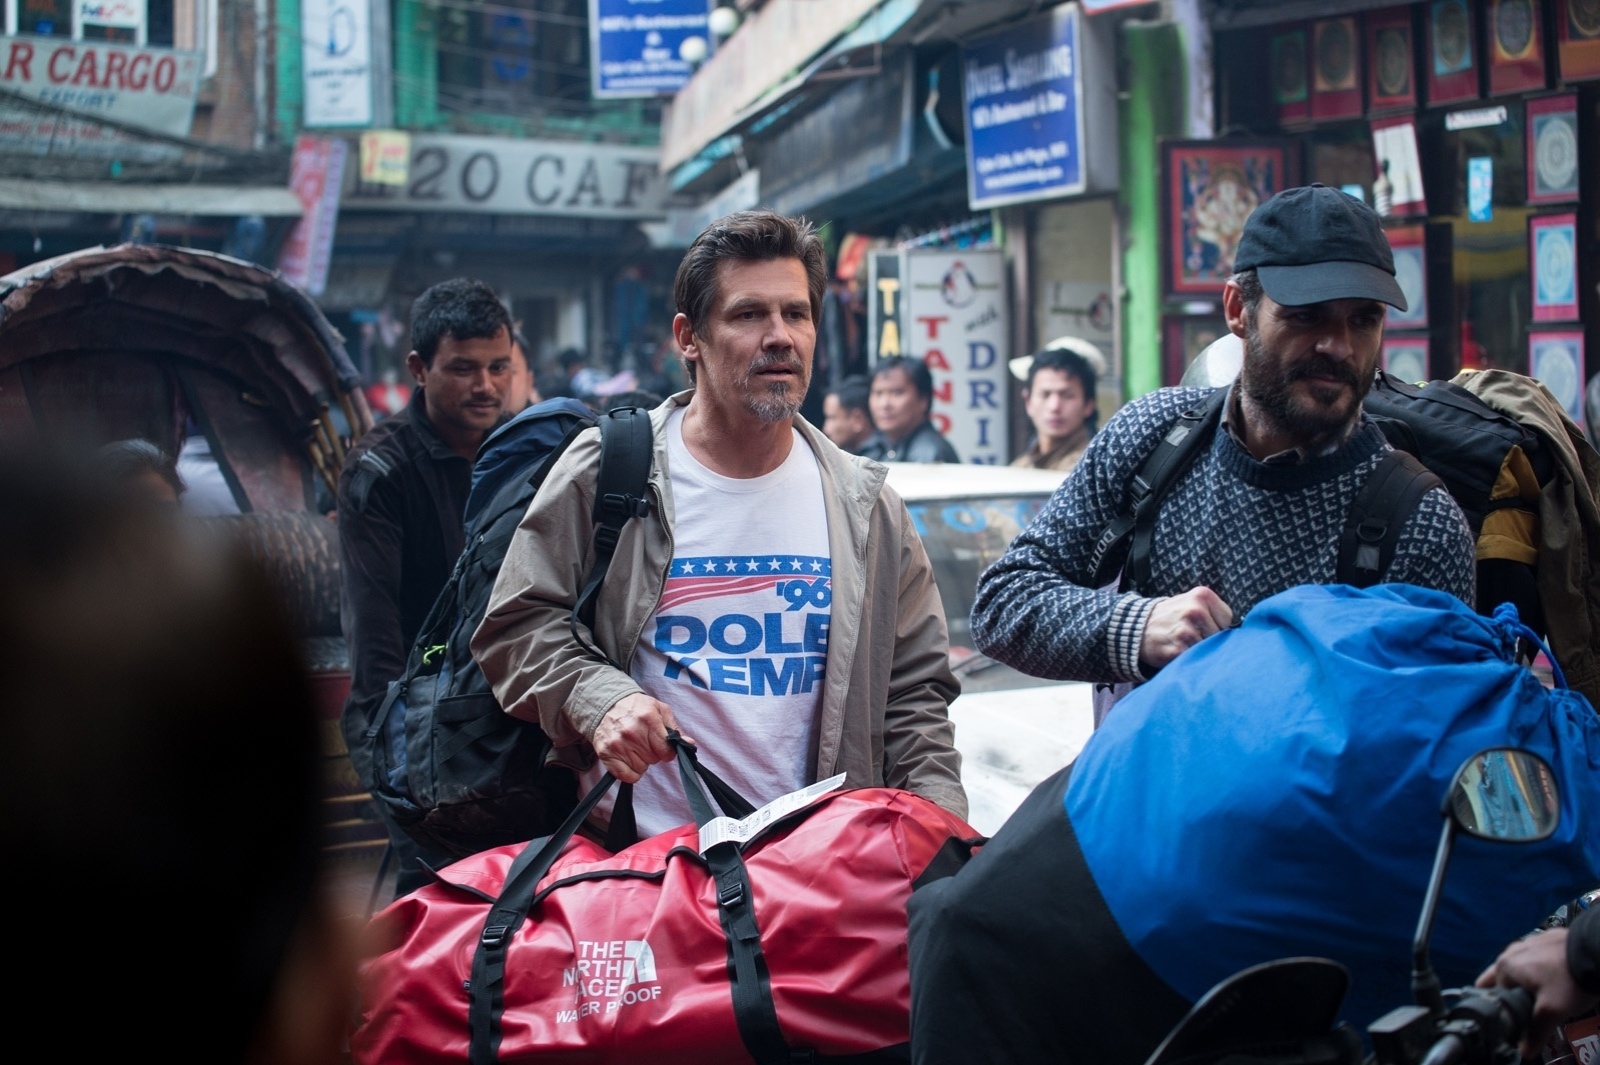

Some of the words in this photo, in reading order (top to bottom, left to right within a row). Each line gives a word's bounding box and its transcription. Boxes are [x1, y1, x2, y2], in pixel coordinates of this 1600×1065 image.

[0, 42, 34, 82] R
[50, 46, 178, 94] CARGO
[526, 154, 692, 209] CAF
[966, 340, 999, 465] DRI
[1086, 528, 1117, 578] DOITE
[776, 577, 832, 612] '96
[654, 612, 830, 655] DOLE
[578, 940, 624, 960] THE
[556, 1001, 601, 1024] WAER
[574, 978, 620, 1004] ACE
